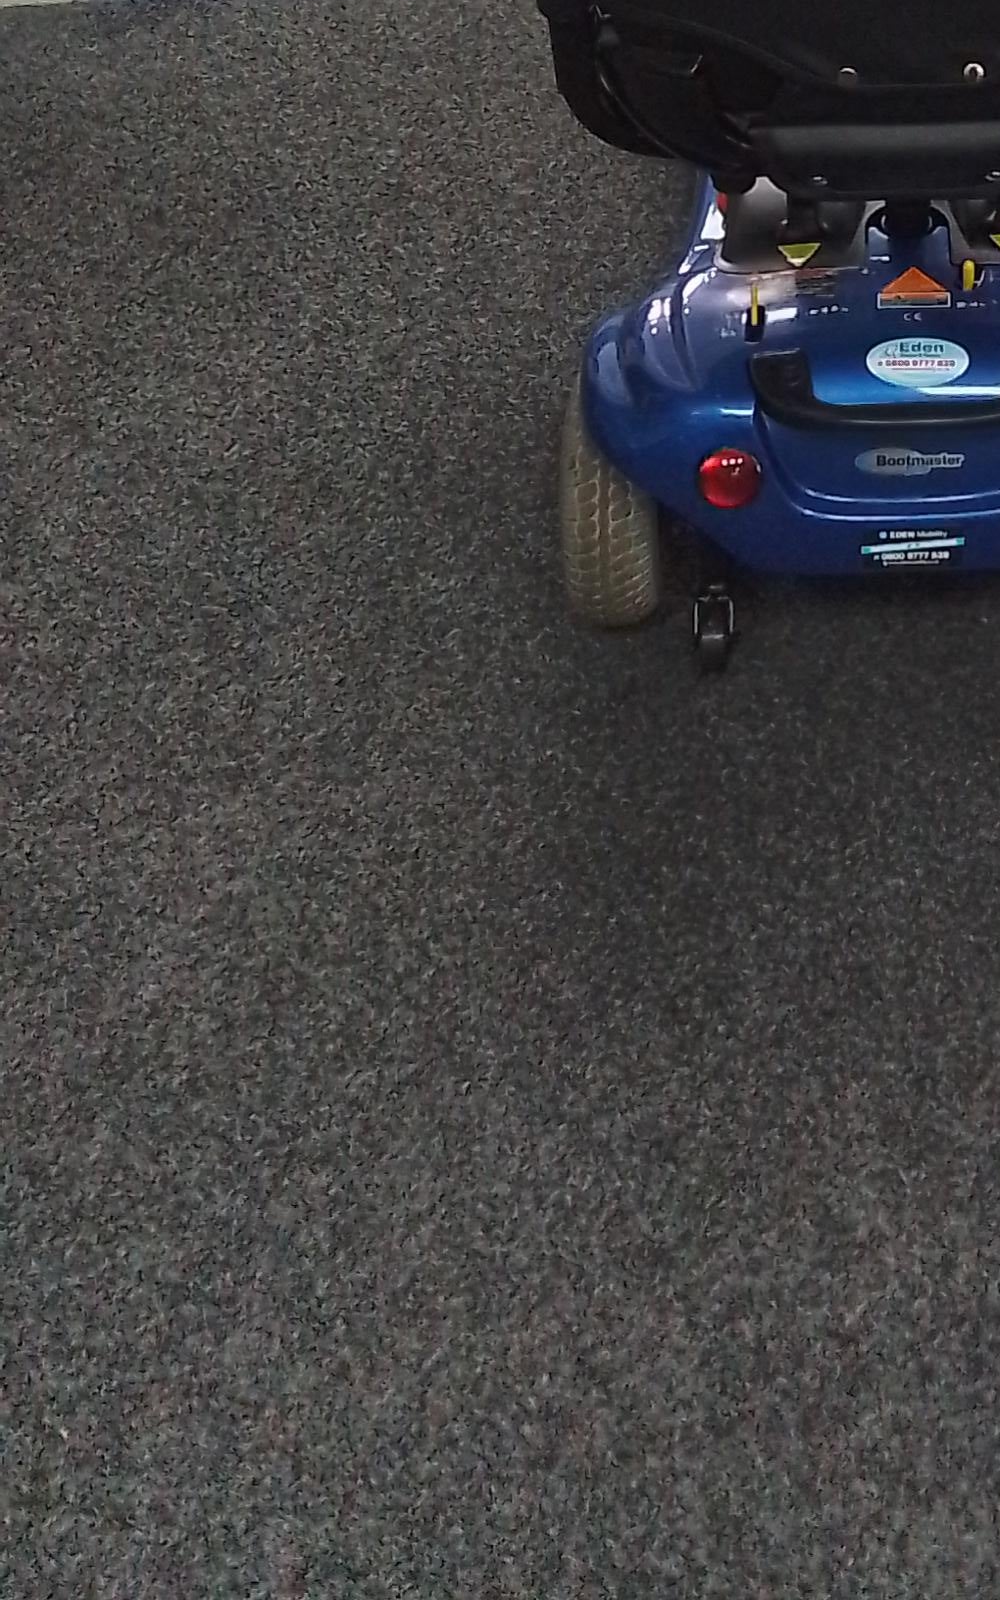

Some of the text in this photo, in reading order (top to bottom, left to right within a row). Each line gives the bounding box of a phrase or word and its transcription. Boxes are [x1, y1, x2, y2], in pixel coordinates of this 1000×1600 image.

[899, 342, 945, 354] Eden
[876, 454, 962, 468] Bootmaster
[889, 530, 916, 540] EDEN
